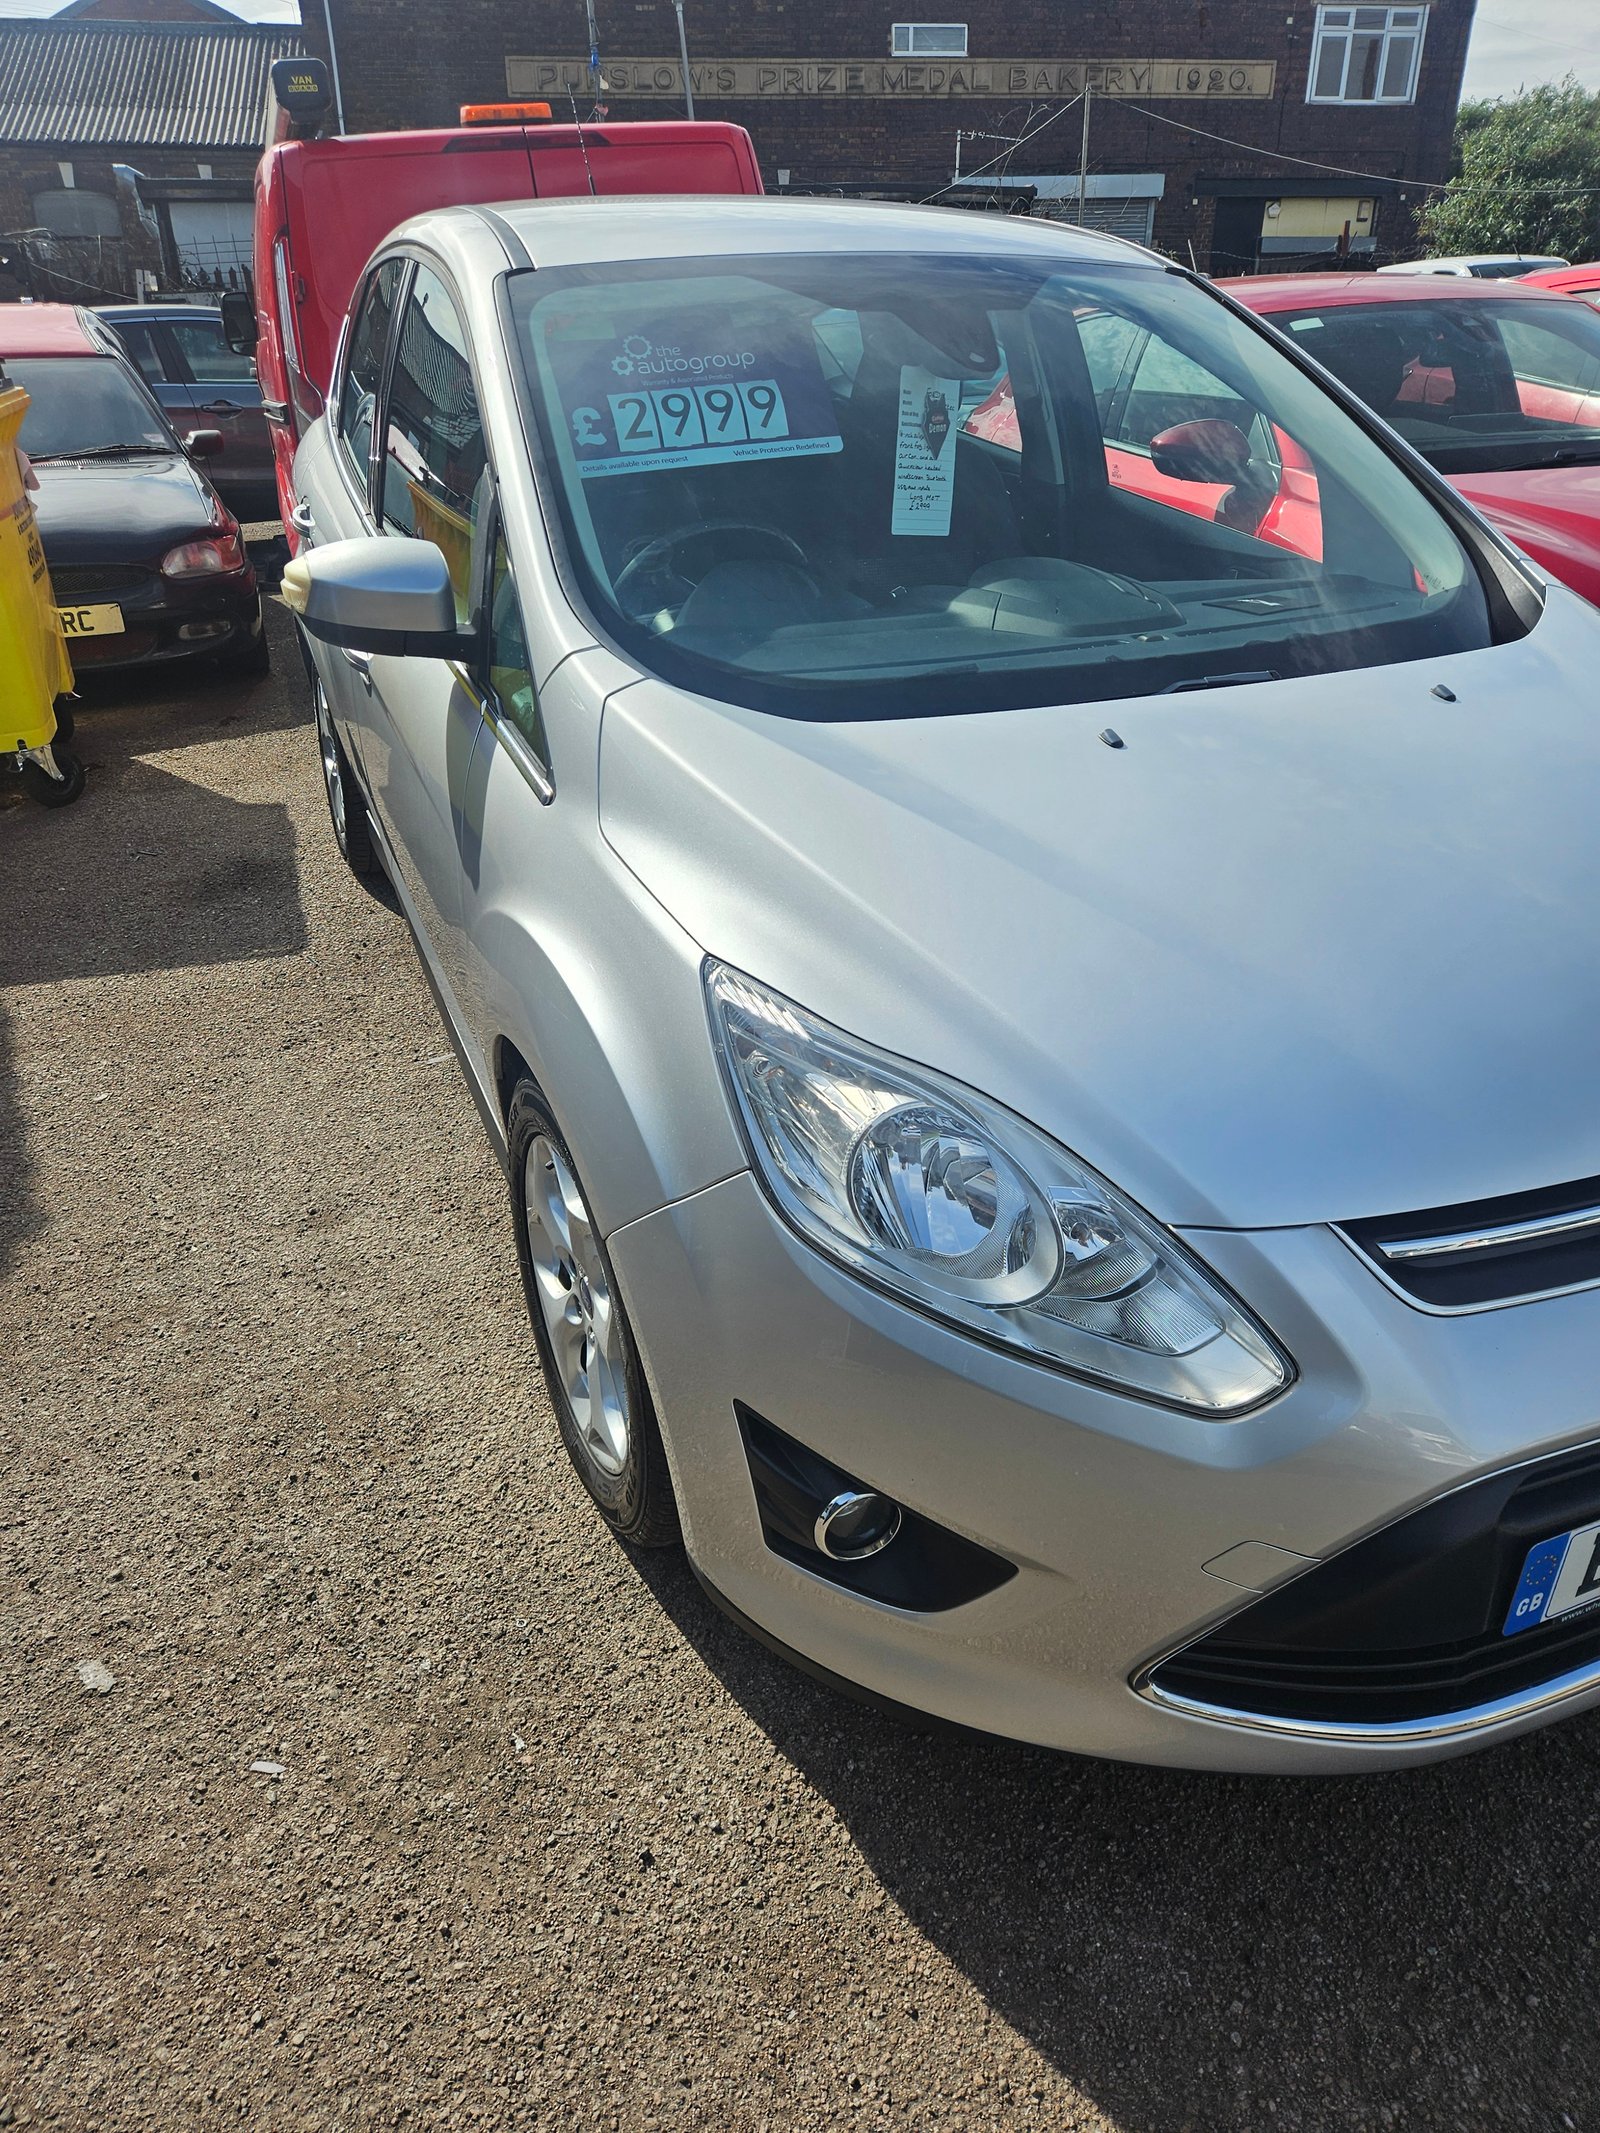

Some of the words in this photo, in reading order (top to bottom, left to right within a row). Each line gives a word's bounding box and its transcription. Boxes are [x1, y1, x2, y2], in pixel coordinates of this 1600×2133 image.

[290, 75, 313, 84] VAN
[758, 67, 865, 92] PRIZE
[881, 65, 992, 91] MEDAL
[1009, 65, 1150, 91] BAKERY
[654, 343, 681, 357] the
[637, 351, 756, 374] autogroup
[928, 423, 947, 434] Demon
[732, 447, 758, 457] Vehicle
[759, 444, 795, 454] Protection
[795, 441, 830, 450] Redefined
[582, 464, 607, 472] Details
[608, 460, 640, 470] available
[641, 459, 660, 468] upon
[661, 455, 688, 466] request
[1515, 1592, 1544, 1617] GB
